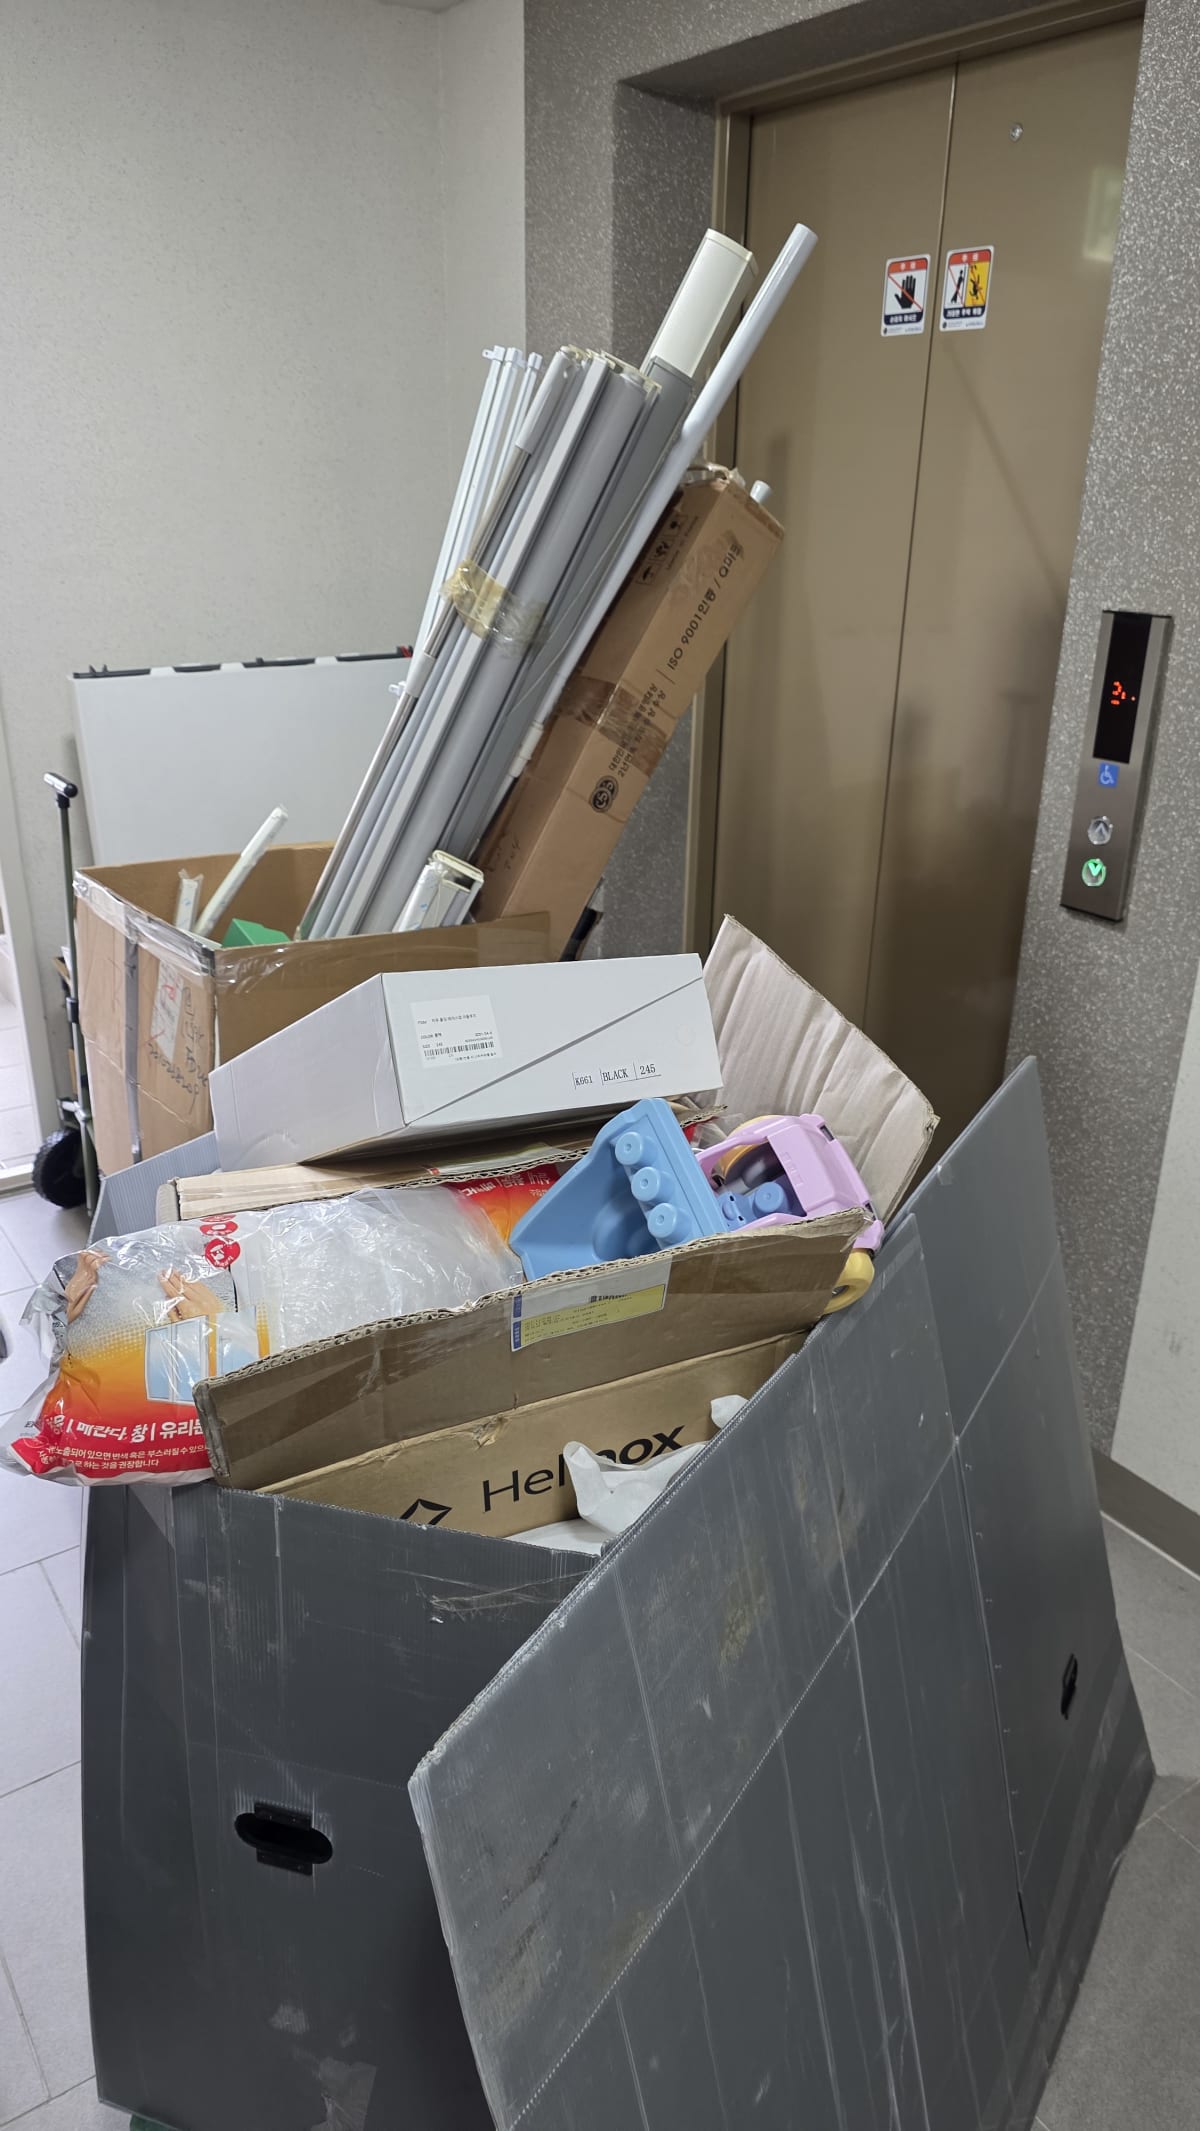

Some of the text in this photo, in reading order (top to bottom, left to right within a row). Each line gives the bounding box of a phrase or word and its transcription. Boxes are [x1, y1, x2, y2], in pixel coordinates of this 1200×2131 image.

[667, 647, 683, 671] ISO
[575, 1063, 656, 1086] K661 BLACK 245
[130, 1424, 149, 1443] 창
[119, 1459, 159, 1470] 권장합니다
